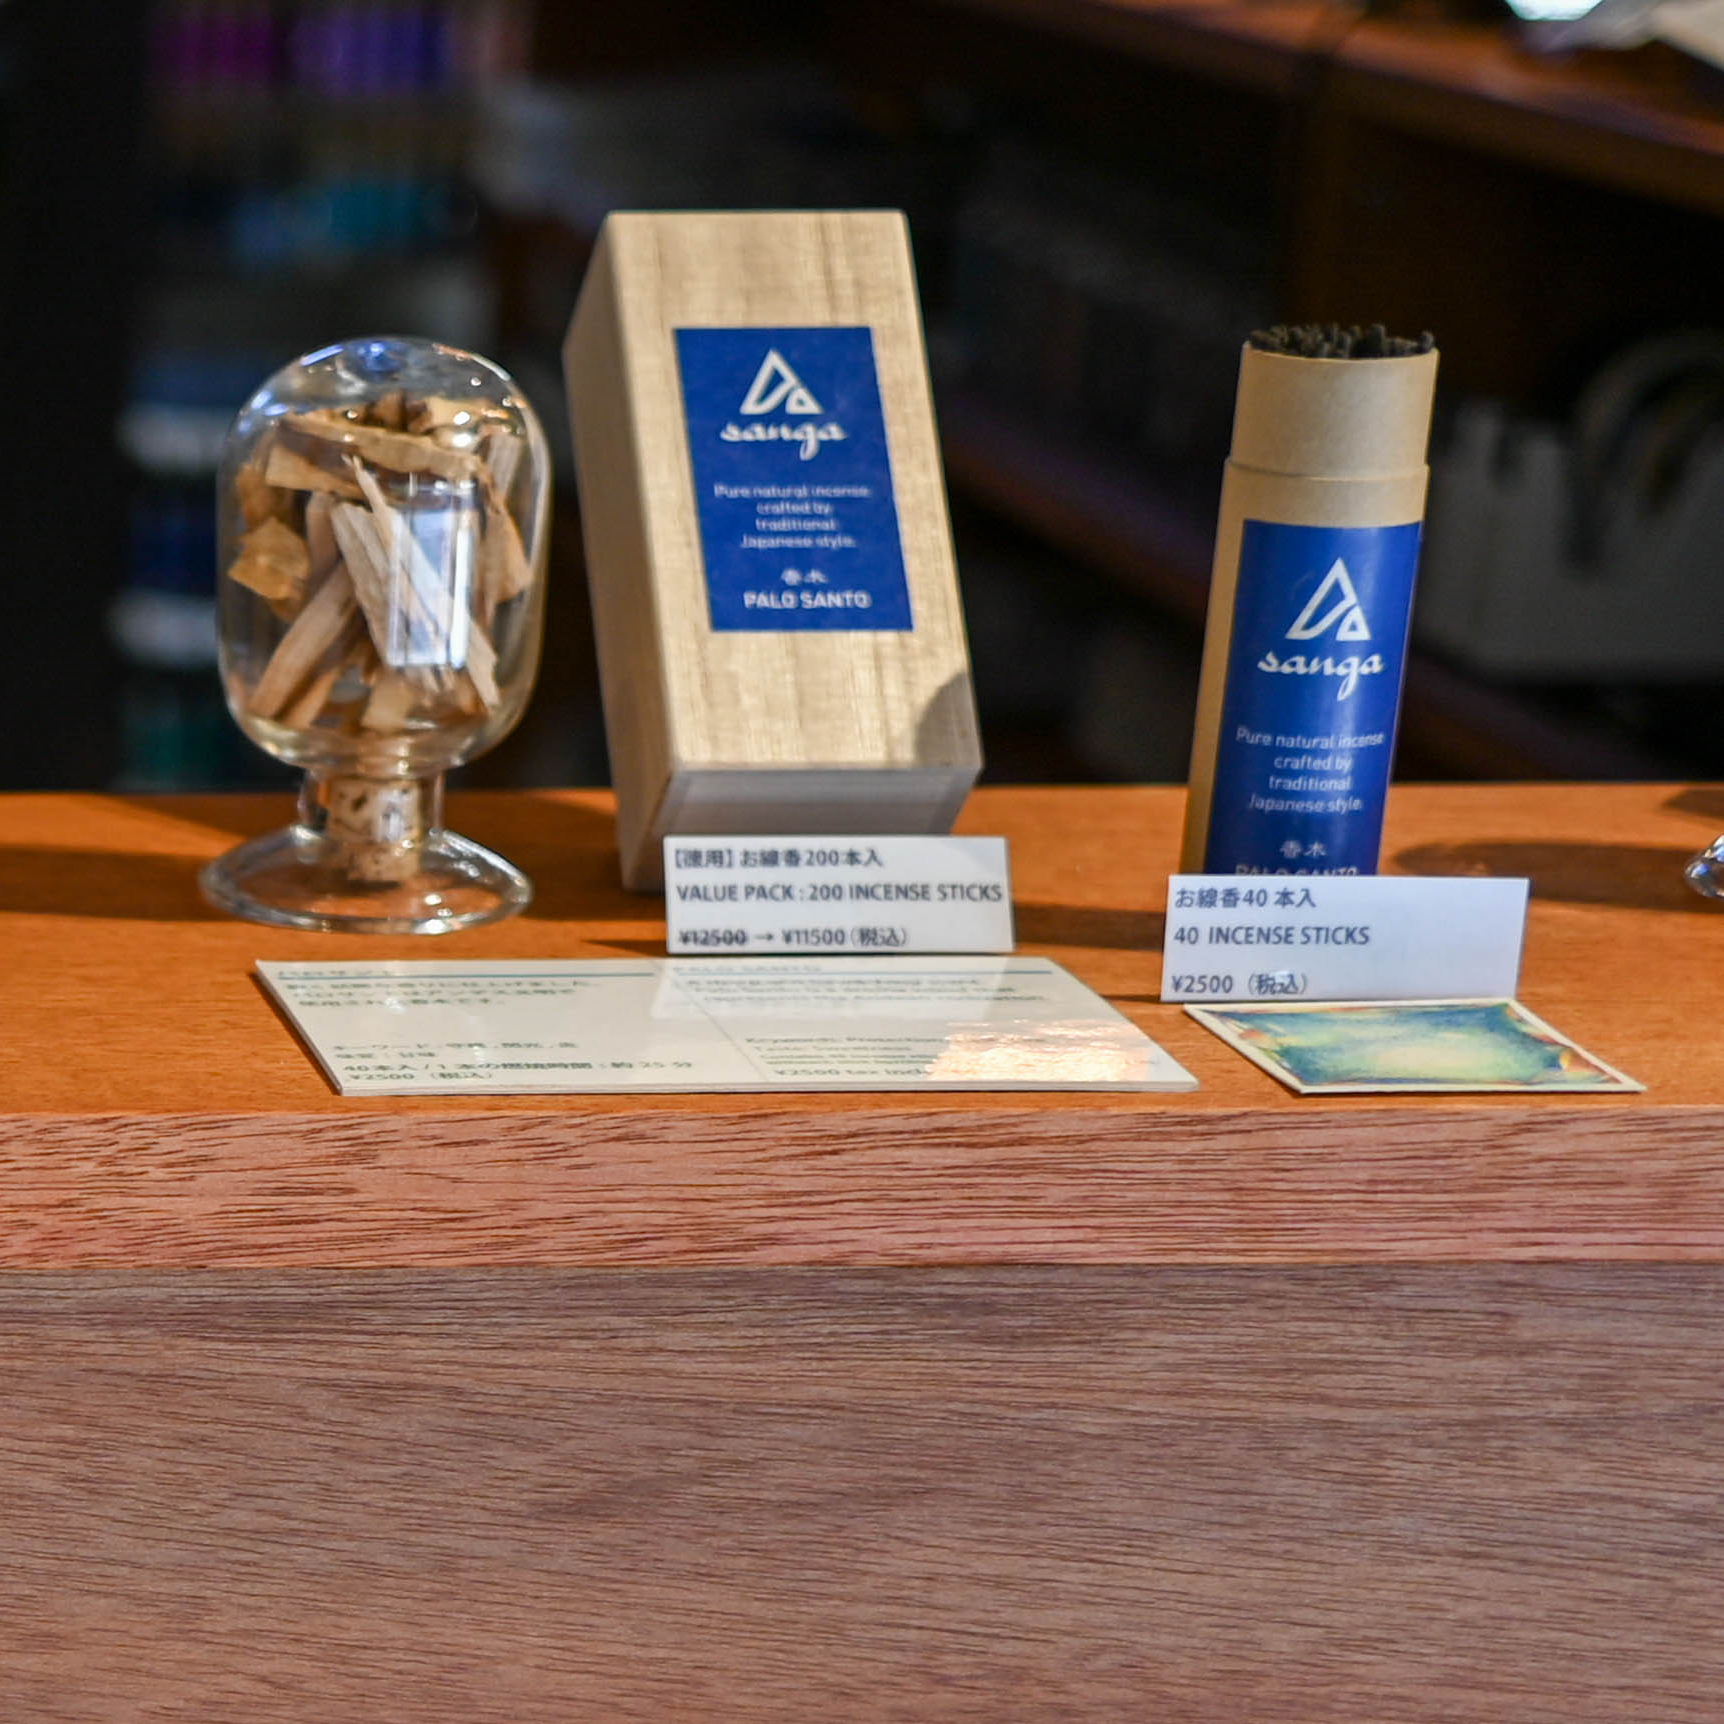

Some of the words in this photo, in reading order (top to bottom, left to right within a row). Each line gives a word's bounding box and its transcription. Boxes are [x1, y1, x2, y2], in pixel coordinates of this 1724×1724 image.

[720, 423, 848, 460] sanga
[744, 591, 796, 608] PALO
[800, 591, 871, 608] SANTO
[1258, 652, 1383, 701] sanga
[1175, 926, 1199, 945] 40
[1209, 926, 1294, 945] INCENSE
[1300, 926, 1369, 945] STICKS
[1172, 975, 1233, 993] ¥2500
